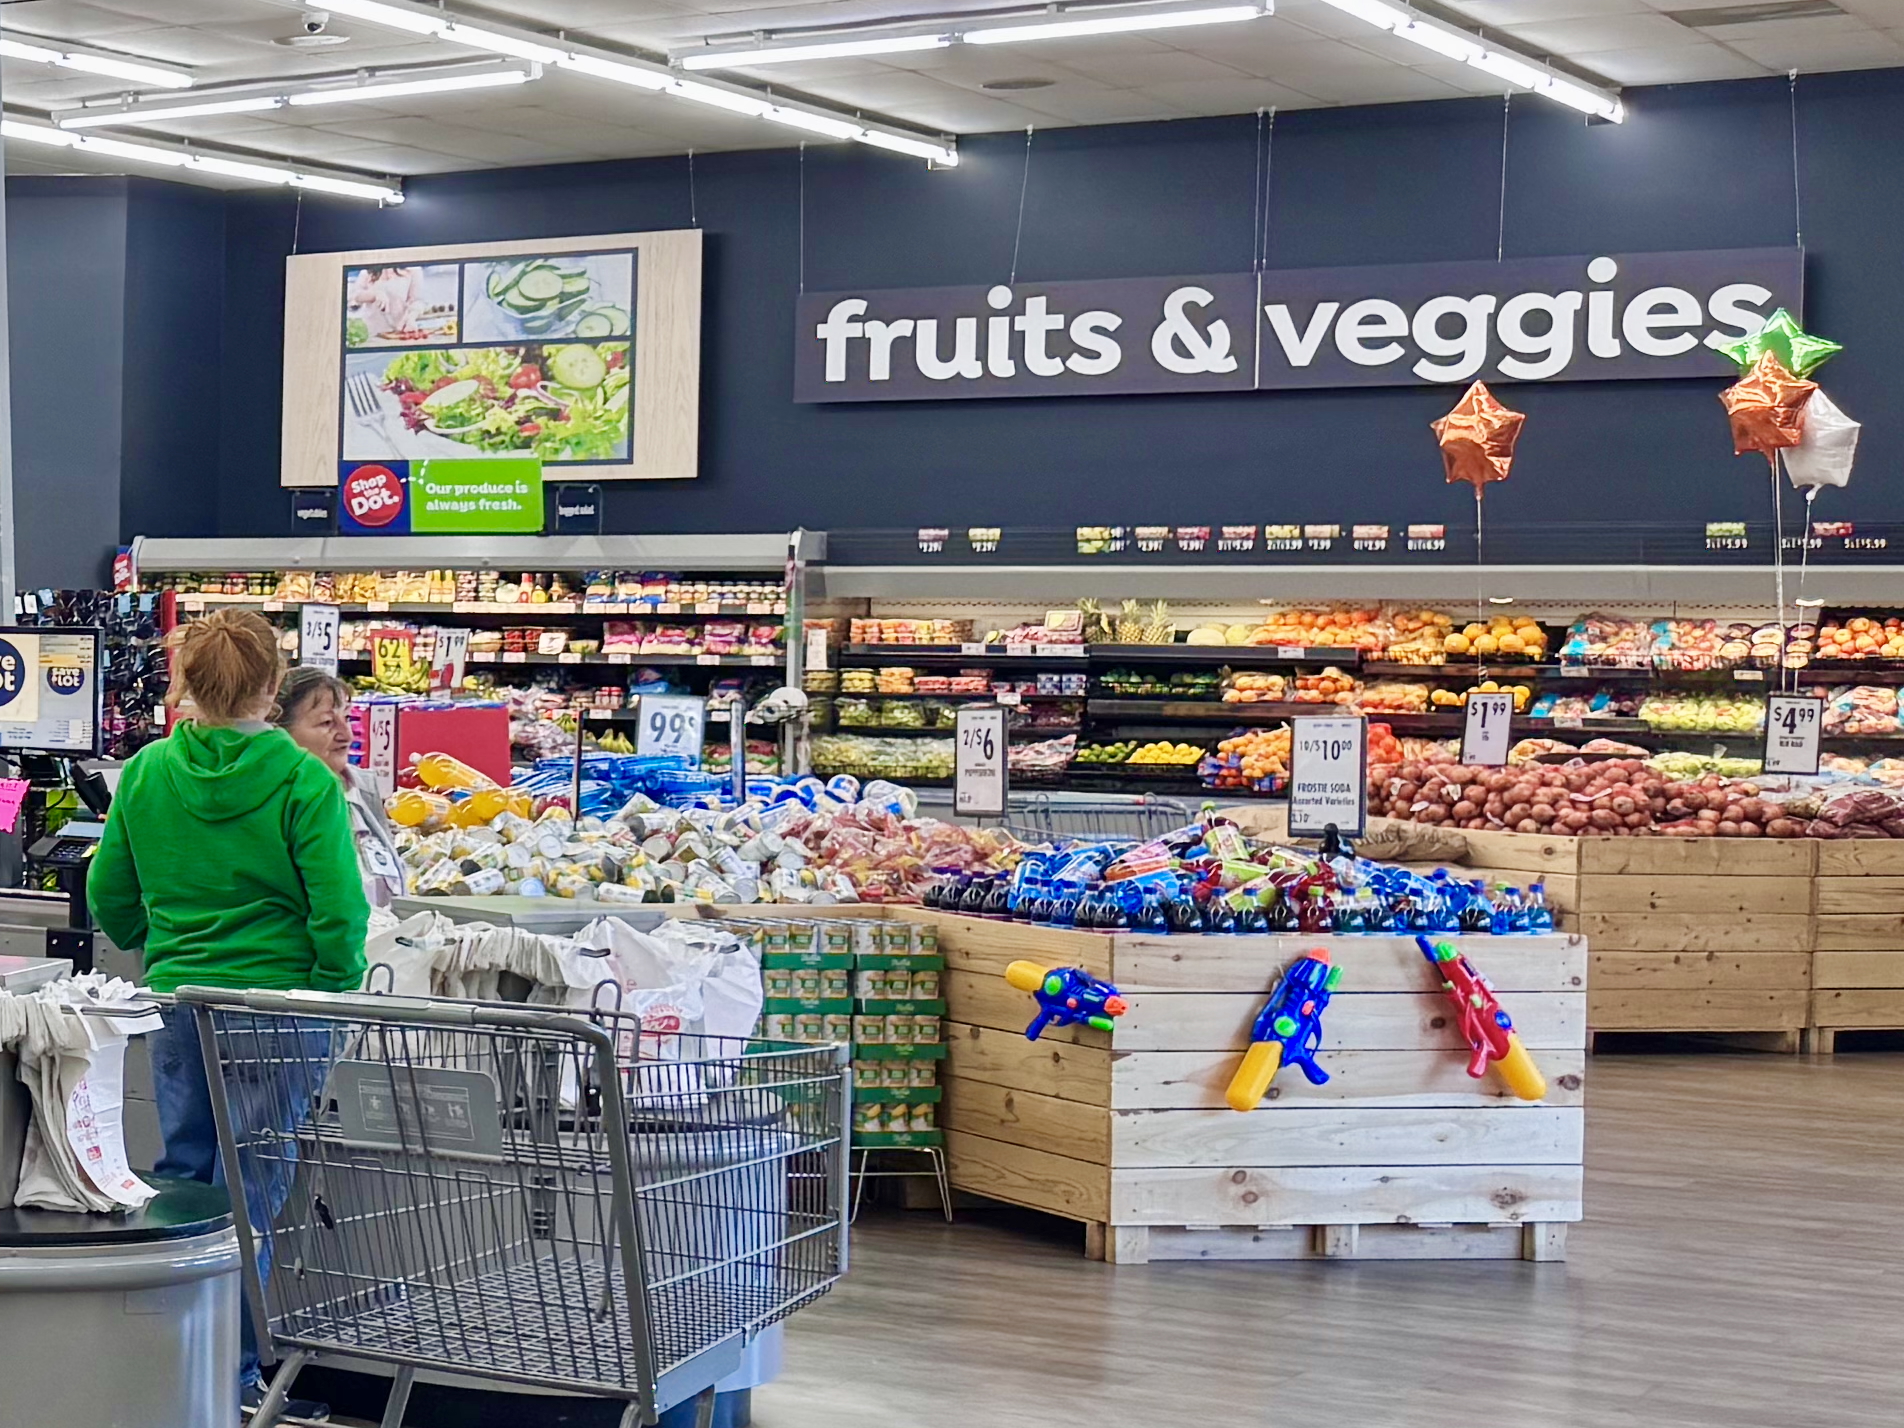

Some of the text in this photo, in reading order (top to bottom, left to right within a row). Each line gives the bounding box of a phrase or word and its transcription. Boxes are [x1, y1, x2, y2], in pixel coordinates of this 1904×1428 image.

[816, 256, 1774, 384] fruits & veggies
[351, 474, 387, 494] Shop
[425, 480, 528, 497] Our produce is
[350, 491, 400, 516] Dot.
[426, 498, 522, 512] always fresh.
[306, 622, 332, 652] 3/$5
[52, 668, 80, 676] save
[1297, 783, 1351, 793] FROSTIE SODA
[1293, 796, 1355, 805] Assorted Varieties
